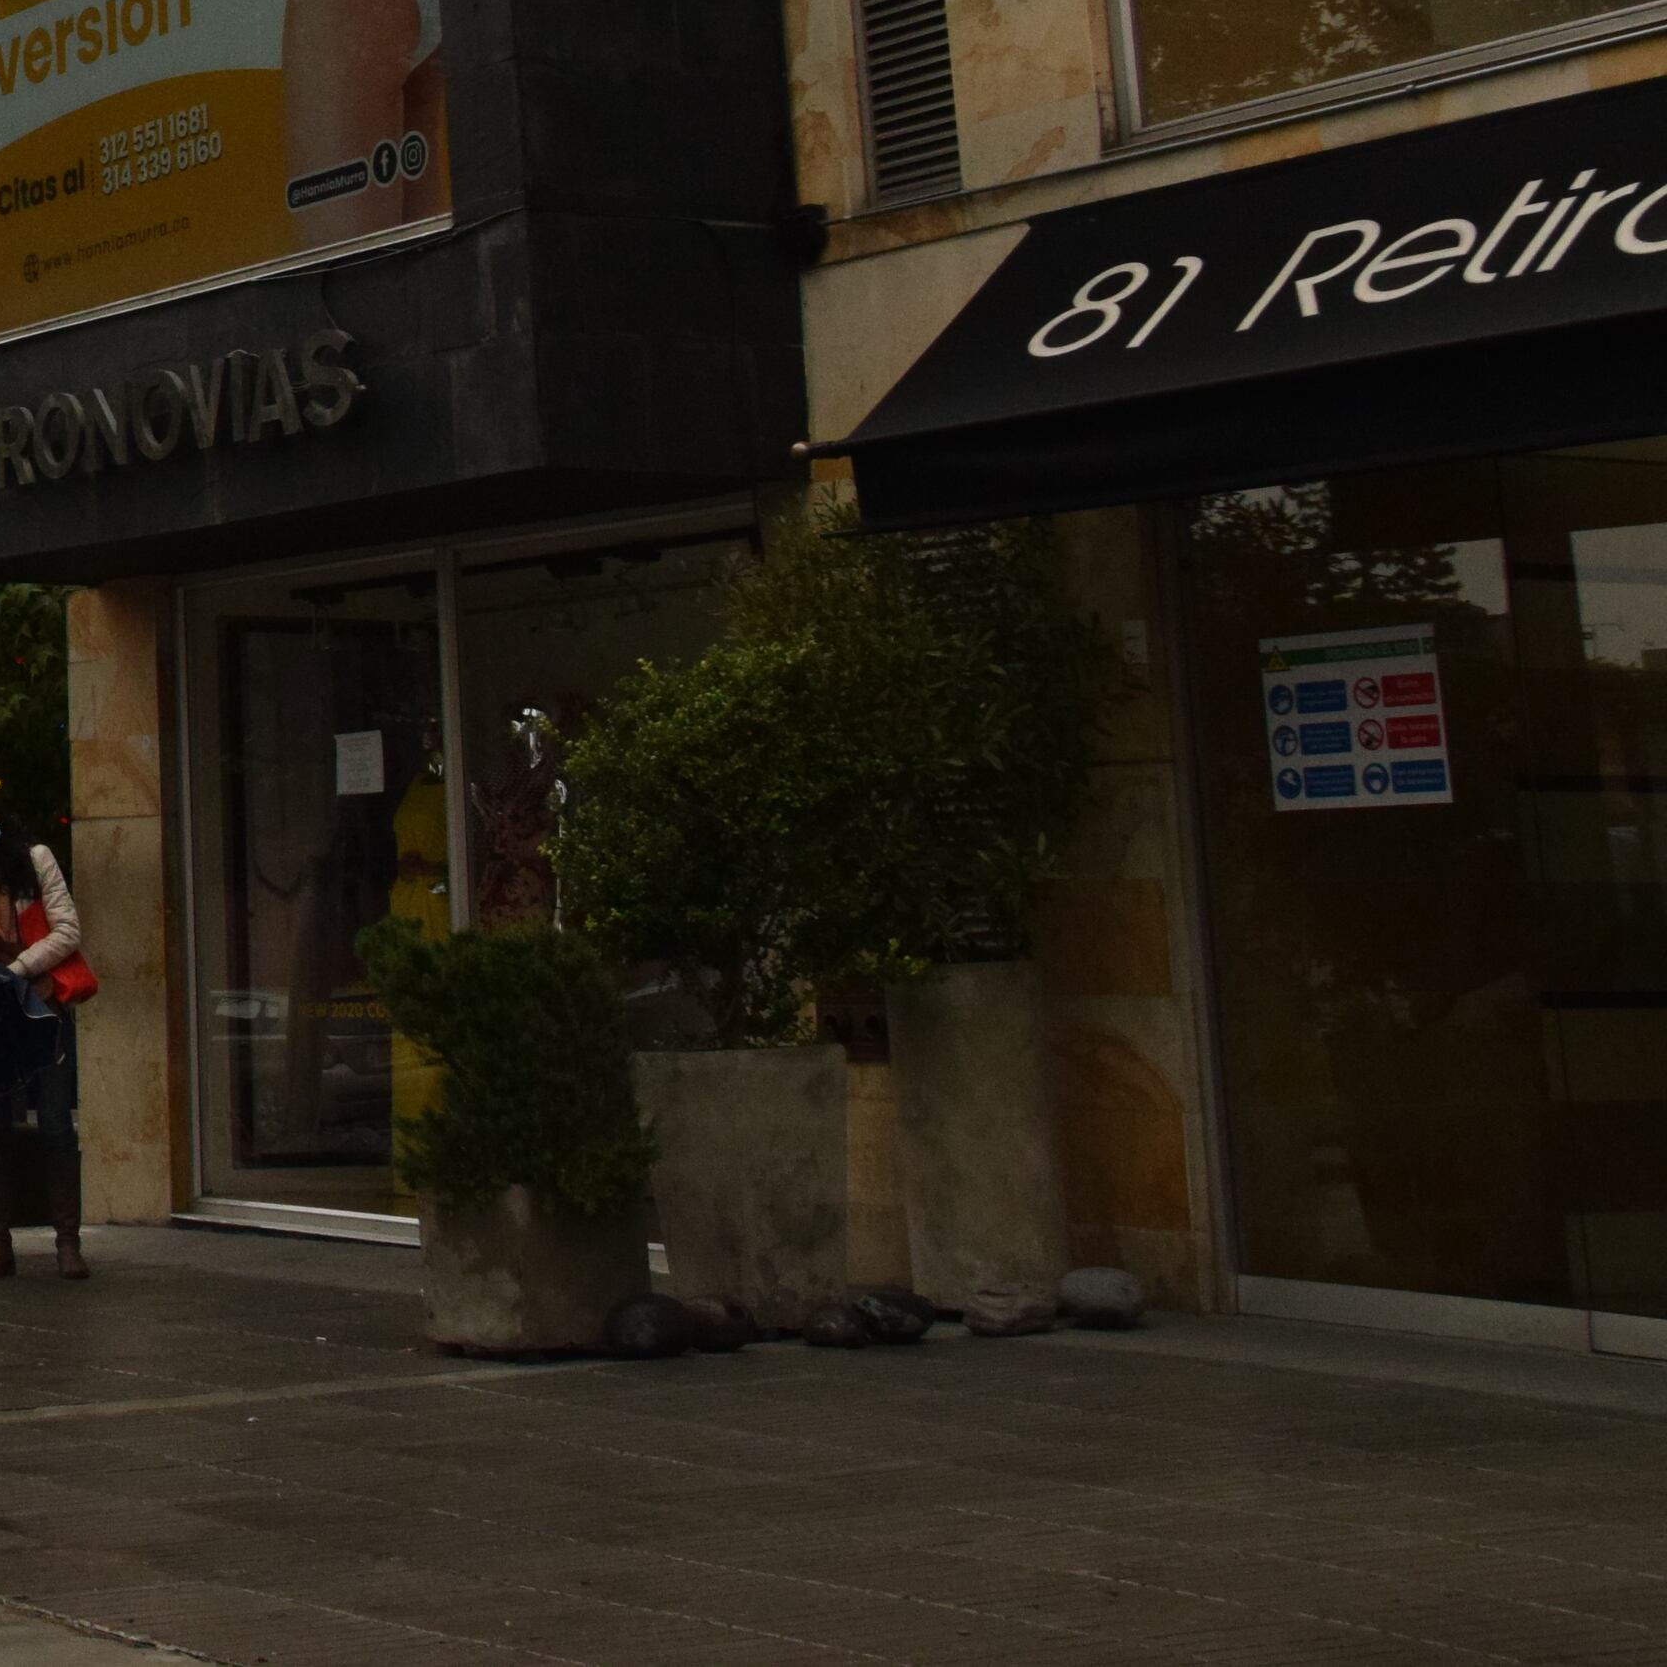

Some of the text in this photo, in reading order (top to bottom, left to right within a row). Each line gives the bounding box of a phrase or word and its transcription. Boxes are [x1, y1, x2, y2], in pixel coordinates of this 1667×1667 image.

[99, 102, 208, 165] 312 551 1681
[63, 158, 85, 195] al
[102, 130, 223, 195] 314 339 6160
[291, 171, 366, 205] @HanniaMurra
[1027, 255, 1203, 358] 81
[330, 1001, 364, 1019] 2020
